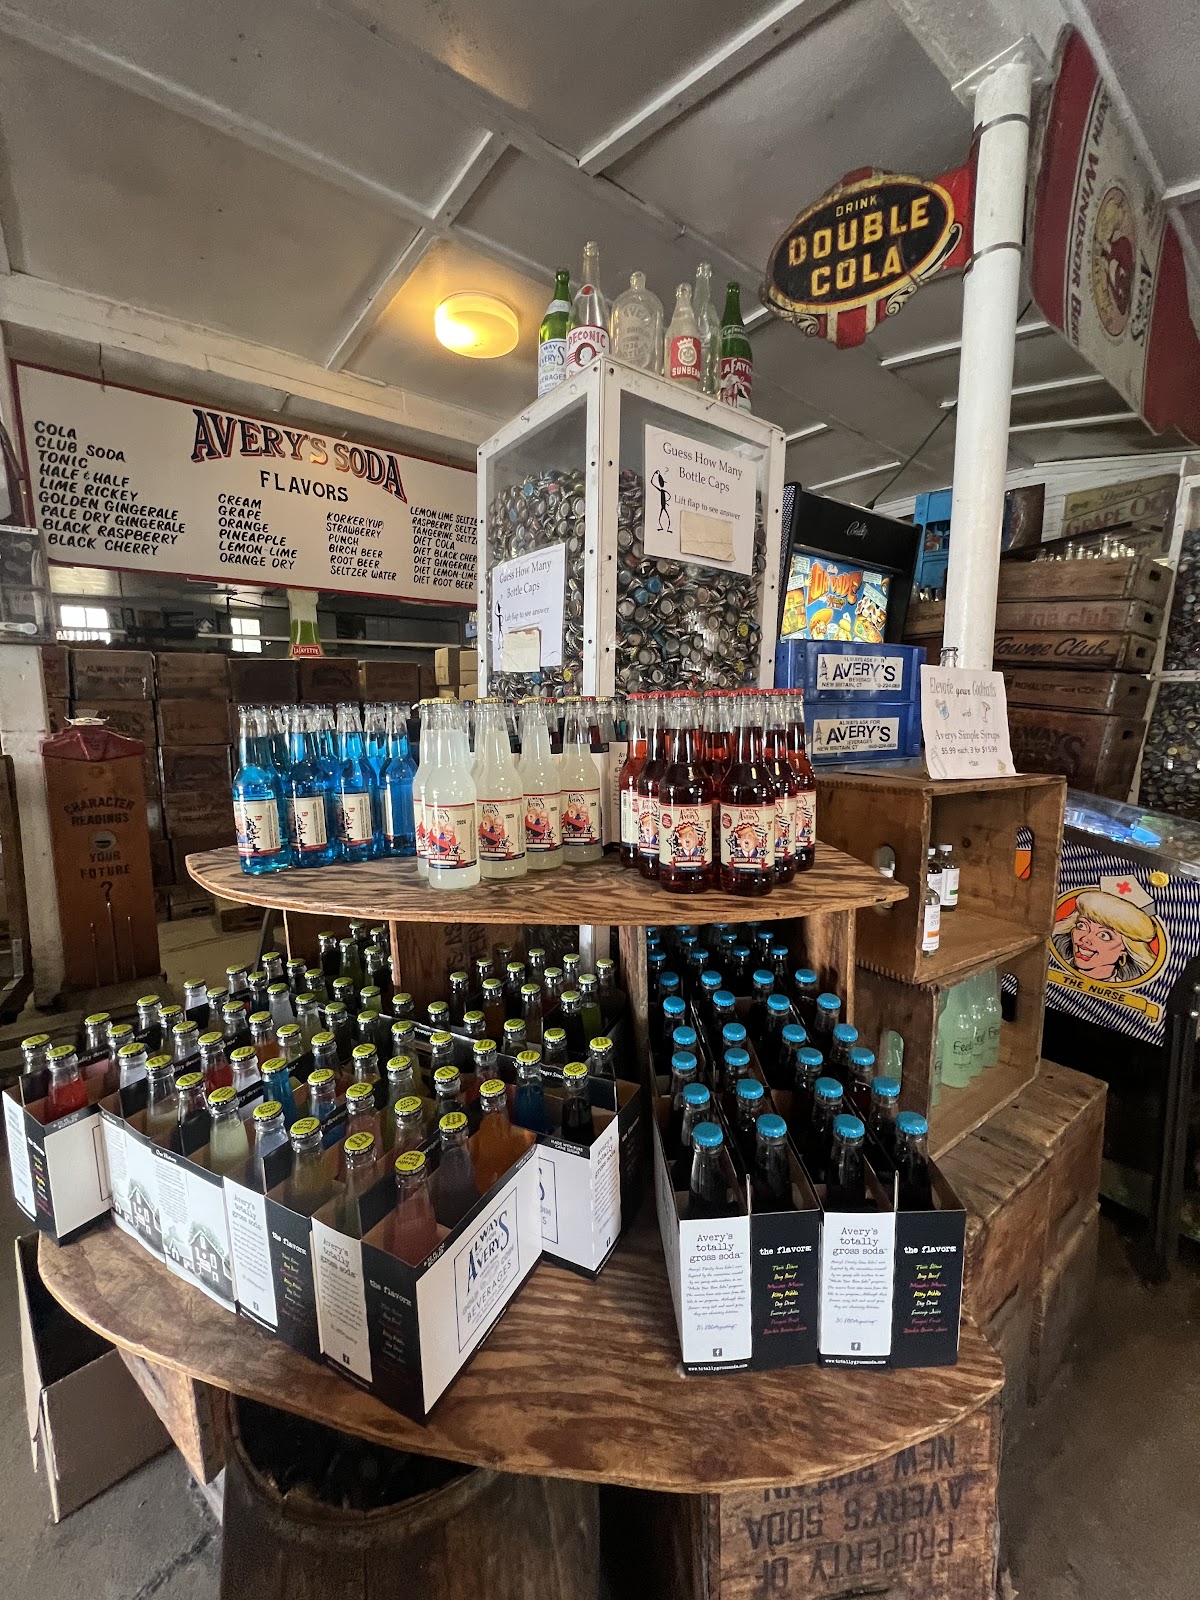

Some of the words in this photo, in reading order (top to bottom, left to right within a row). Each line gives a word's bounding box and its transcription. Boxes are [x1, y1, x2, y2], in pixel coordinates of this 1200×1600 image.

[836, 194, 878, 217] DRINK
[1072, 154, 1099, 287] WINDSOR
[788, 195, 930, 267] DOUBLE
[812, 247, 901, 297] COLA
[569, 330, 606, 348] PECONIC
[34, 421, 77, 440] COLA
[36, 435, 77, 453] CLUB
[86, 445, 126, 462] SODA
[191, 409, 328, 464] AVERY'S
[334, 443, 407, 504] SODA
[38, 450, 88, 468] TONIC
[663, 442, 692, 461] Guess
[695, 451, 716, 468] How
[719, 460, 742, 480] Many
[40, 463, 79, 480] HALF
[84, 471, 90, 480] &
[93, 472, 129, 487] HALF
[679, 467, 706, 485] Bottle
[708, 476, 730, 493] Caps
[40, 477, 78, 493] LIME
[84, 484, 138, 501] RICKEY
[260, 470, 349, 502] FLAVORS
[39, 491, 98, 510] GOLDEN
[104, 501, 178, 520] GINGERALE
[218, 493, 262, 509] CREAM
[674, 495, 686, 505] Lift
[687, 497, 700, 510] flap
[702, 502, 707, 510] to
[709, 506, 718, 514] see
[720, 509, 740, 520] answer
[41, 505, 76, 519] PALE
[83, 510, 110, 524] DRY
[115, 515, 185, 533] GINGERALE
[218, 506, 262, 520] GRAPE
[43, 519, 91, 535] BLACK
[98, 525, 178, 544] RASPBERRY
[219, 518, 269, 533] ORANGE
[326, 523, 381, 538] STRAWBERRY
[412, 517, 451, 530] RASPBERRY
[219, 529, 286, 546] PINEAPPLE
[328, 534, 359, 546] PUNCH
[413, 526, 453, 540] TANGERINE
[48, 534, 97, 549] BLACK
[105, 540, 158, 555] CHERRY
[329, 544, 356, 555] BIRCH
[361, 549, 383, 559] BEER
[414, 536, 432, 546] DIET
[436, 539, 455, 550] COLA
[220, 553, 266, 566] ORANGE
[272, 558, 295, 570] DRY
[413, 546, 431, 556] DIET
[434, 550, 457, 560] BLACK
[330, 555, 353, 565] ROOT
[357, 558, 380, 569] BEER
[414, 556, 431, 566] DIET
[434, 559, 475, 572] GINGERALE
[414, 566, 431, 575] DIET
[331, 565, 368, 577] SELTZER
[371, 571, 397, 581] WATER
[500, 572, 514, 583] Guess
[516, 566, 530, 578] How
[532, 560, 551, 573] Many
[414, 575, 430, 584] DIET
[433, 578, 452, 587] ROOT
[456, 580, 474, 590] BEER
[507, 586, 523, 598] Bottle
[523, 581, 540, 596] Caps
[1054, 637, 1110, 656] Club
[832, 663, 895, 681] AVERY'S
[956, 688, 971, 698] your
[826, 725, 890, 745] AVERY'S
[935, 730, 957, 742] Averys
[958, 730, 979, 742] Simple
[980, 730, 1000, 742] Syrups
[64, 797, 135, 814] CHARACTER
[72, 813, 129, 826] READINGS
[90, 851, 120, 862] YOUR
[100, 881, 113, 901] ?
[1063, 977, 1084, 988] THE
[1089, 985, 1126, 1002] NURSE
[272, 1231, 282, 1242] the
[697, 1233, 733, 1242] Avery's
[841, 1227, 879, 1237] Avery's
[696, 1243, 734, 1251] totally
[840, 1237, 878, 1247] totally
[904, 1246, 918, 1254] the
[690, 1255, 716, 1263] gross
[833, 1248, 860, 1256] gross
[369, 1279, 381, 1291] the
[467, 1259, 512, 1323] BEVERAGES
[895, 1436, 955, 1476] NEW
[844, 1474, 970, 1532] AVERY'S
[744, 1503, 823, 1550] SODA
[809, 1522, 953, 1584] PROPERTY
[762, 1556, 789, 1592] OF
